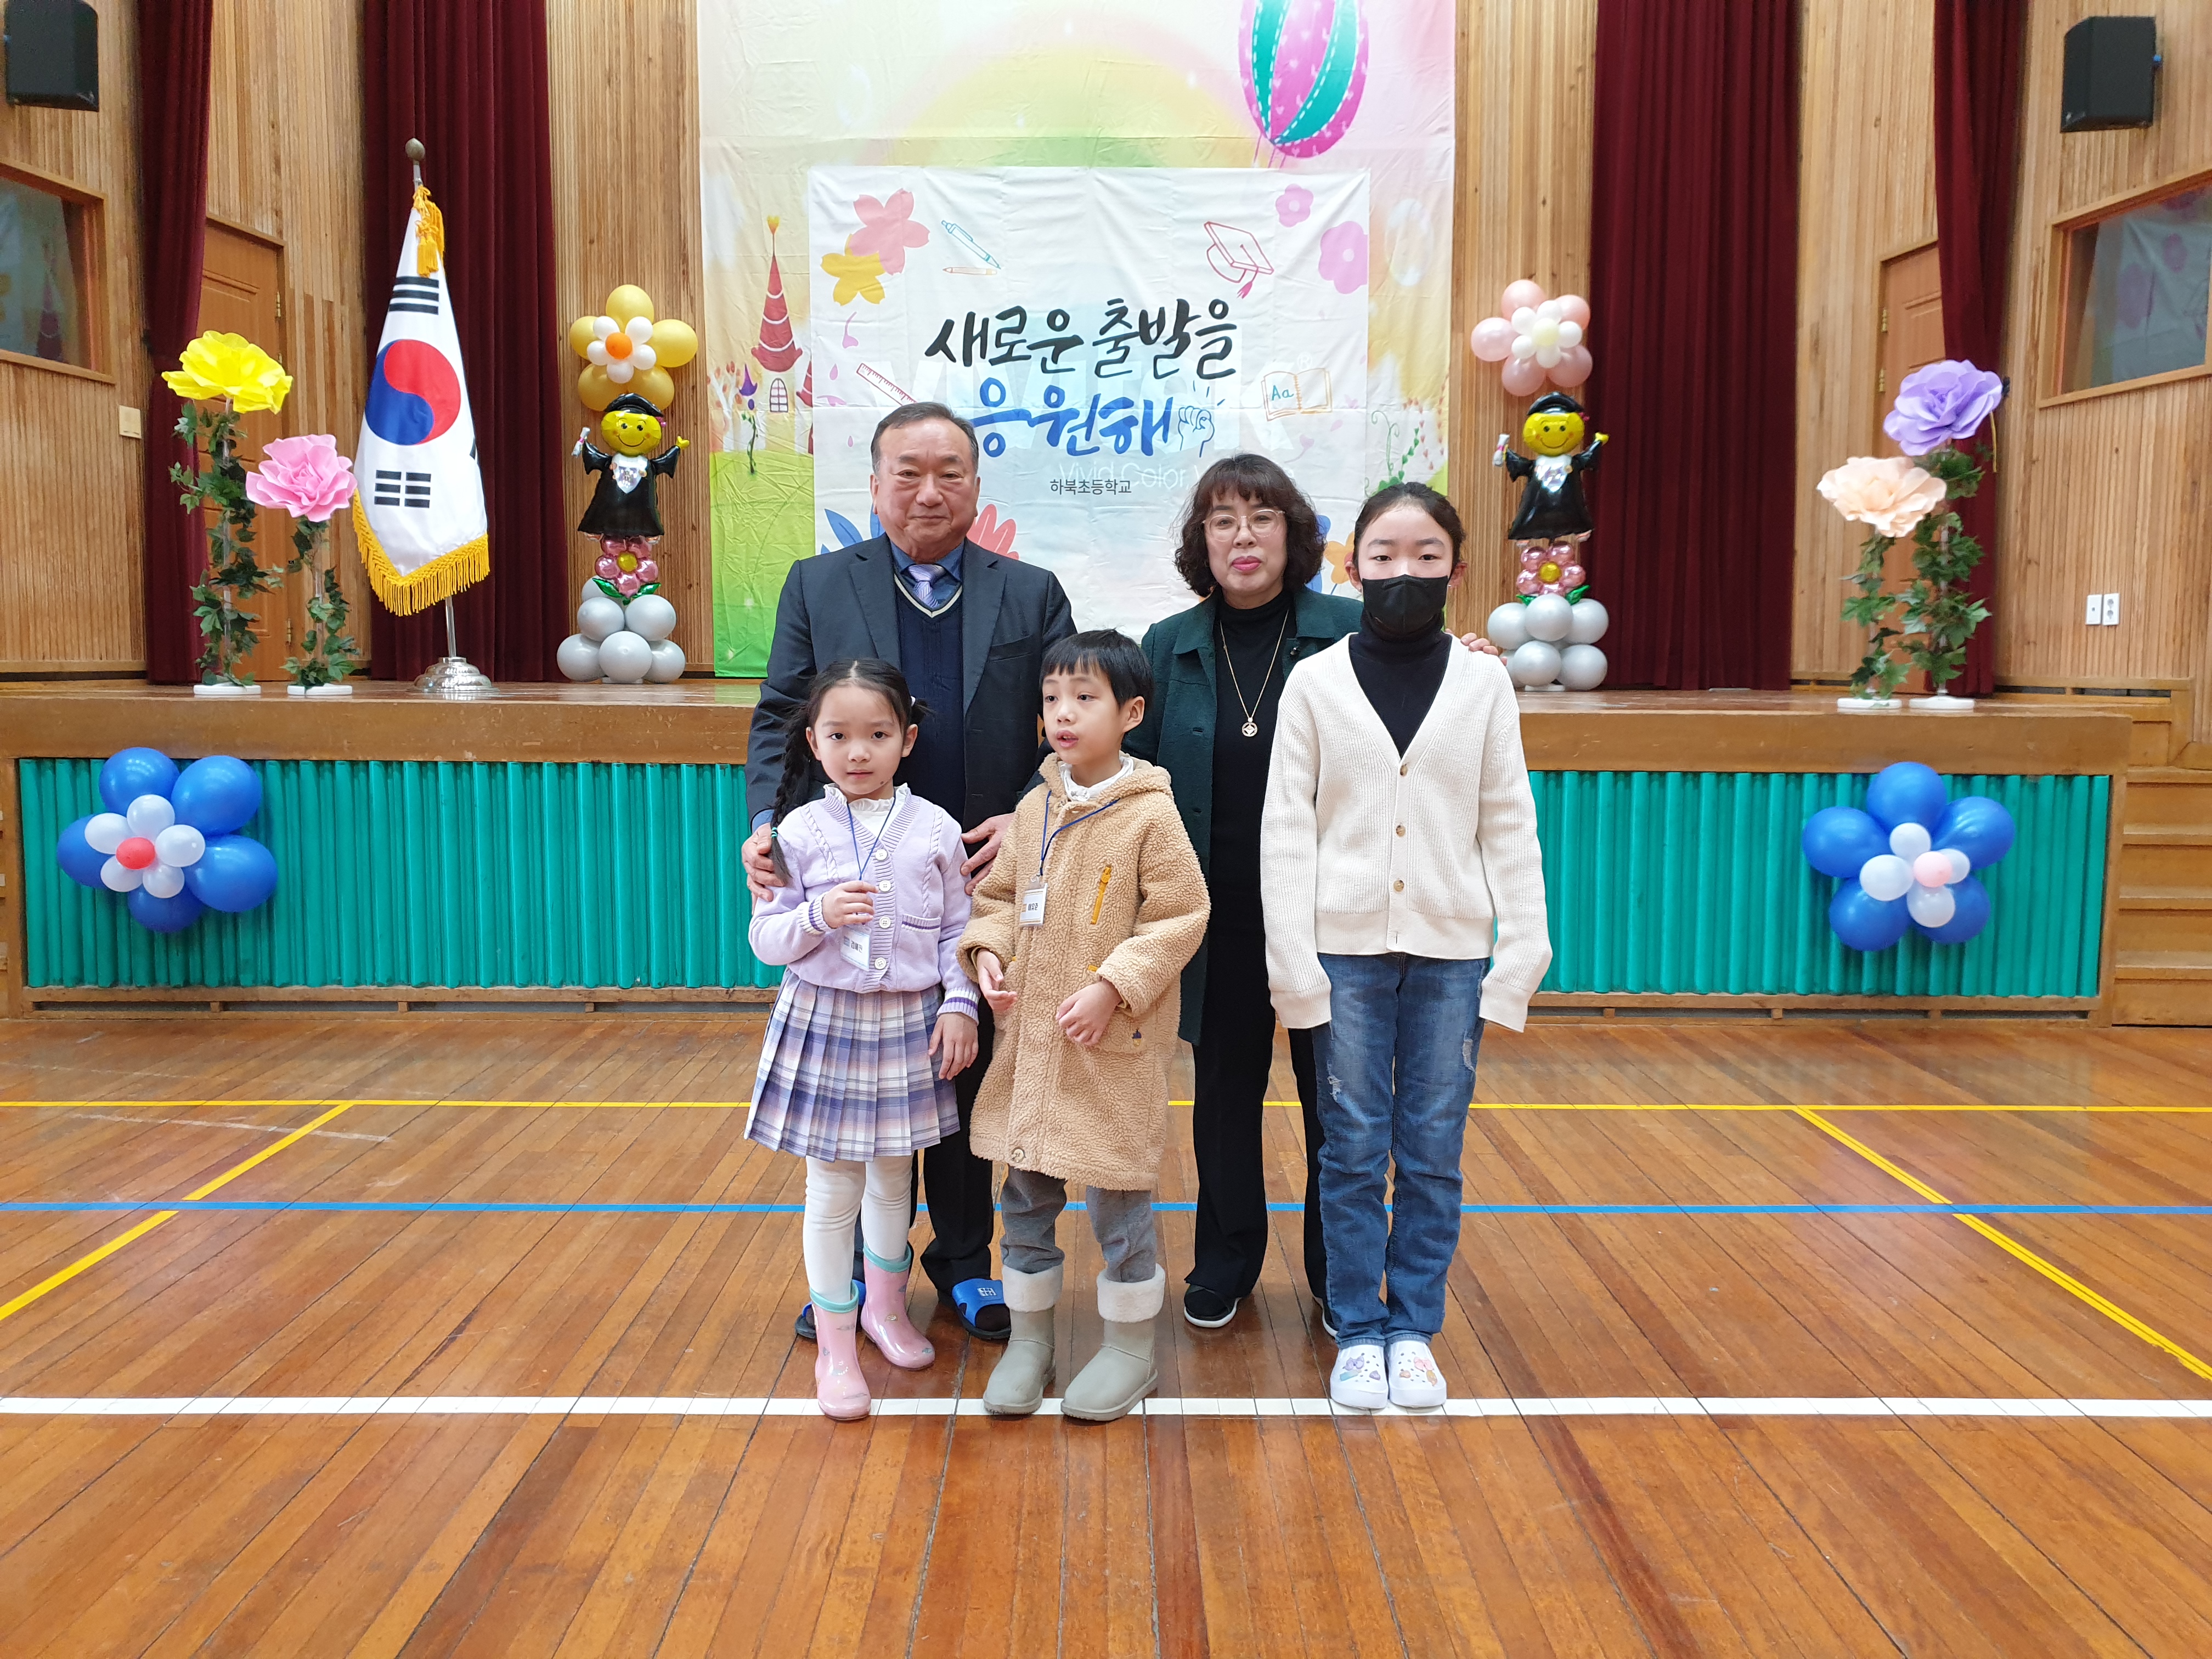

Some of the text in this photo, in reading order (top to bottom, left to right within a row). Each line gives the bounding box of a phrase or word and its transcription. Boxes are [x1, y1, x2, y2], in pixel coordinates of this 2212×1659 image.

[924, 298, 1238, 380] 새로운 출발을
[972, 377, 1173, 458] 응원해
[1271, 385, 1295, 401] Aa
[1049, 478, 1132, 495] 하북초등학교
